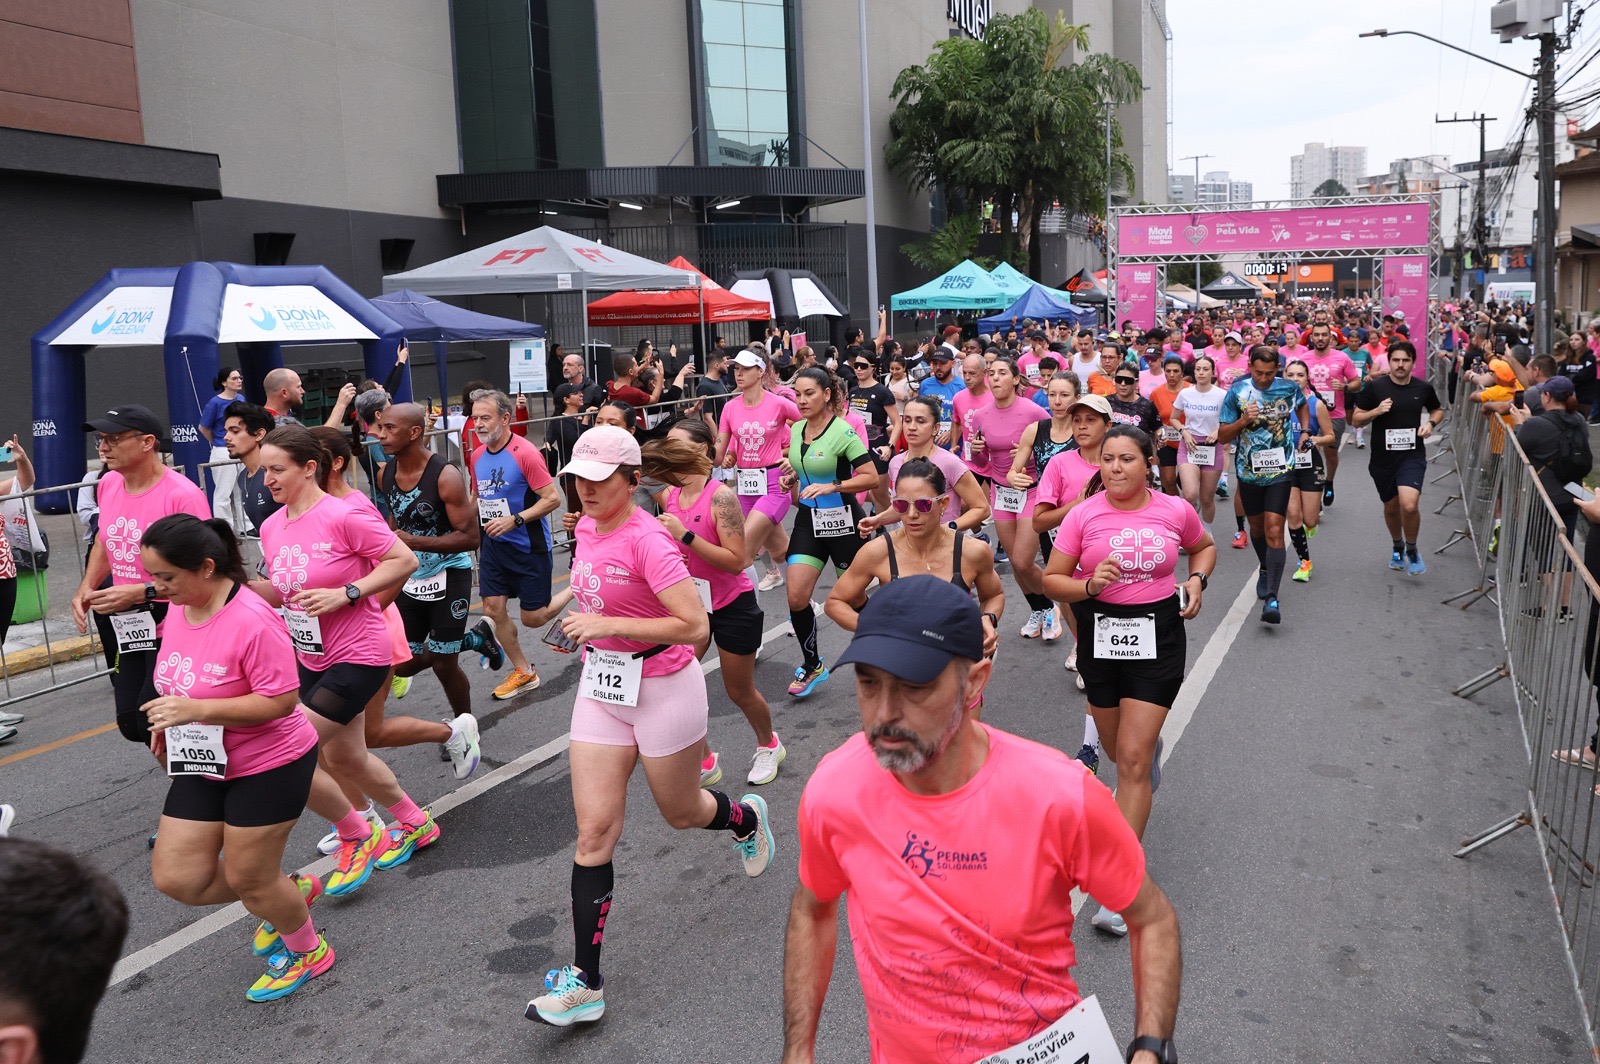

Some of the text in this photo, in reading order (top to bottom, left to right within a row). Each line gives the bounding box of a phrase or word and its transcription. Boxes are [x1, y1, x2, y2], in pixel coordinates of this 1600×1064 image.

[1148, 226, 1173, 235] Movi
[1216, 226, 1260, 235] Pela Vida
[482, 247, 548, 266] FT
[572, 247, 615, 263] FT
[943, 275, 976, 283] BIKE
[939, 282, 973, 290] RUN
[898, 298, 927, 306] BIKERUN
[115, 310, 154, 324] DONA
[276, 309, 331, 321] DONA
[108, 323, 146, 335] HELENA
[283, 320, 337, 331] HELENA
[1184, 403, 1219, 412] Araquari
[32, 421, 57, 430] DONA
[32, 429, 57, 437] HELENA
[171, 426, 198, 435] DONA
[172, 434, 199, 442] HELENA
[575, 447, 599, 455] OCEANO
[1259, 459, 1280, 467] 1065
[744, 480, 758, 488] 510
[1003, 497, 1018, 505] 684
[821, 520, 846, 529] 1038
[818, 528, 850, 536] JAQUELINE
[112, 562, 137, 572] Corrida
[605, 577, 631, 586] Mueller
[413, 582, 440, 594] 1040
[123, 618, 144, 626] PelaVida
[125, 628, 150, 640] 1007
[1110, 634, 1139, 646] 642
[128, 641, 154, 650] GERALDO
[598, 656, 626, 667] PelaVida
[597, 672, 622, 688] 112
[592, 689, 626, 702] GISLENE
[183, 733, 209, 741] PelaVida
[180, 747, 216, 761] 1050
[183, 763, 217, 773] INDIANA
[936, 851, 987, 862] PERNAS
[1027, 1029, 1059, 1052] Corrida
[1016, 1030, 1076, 1064] PelaVida
